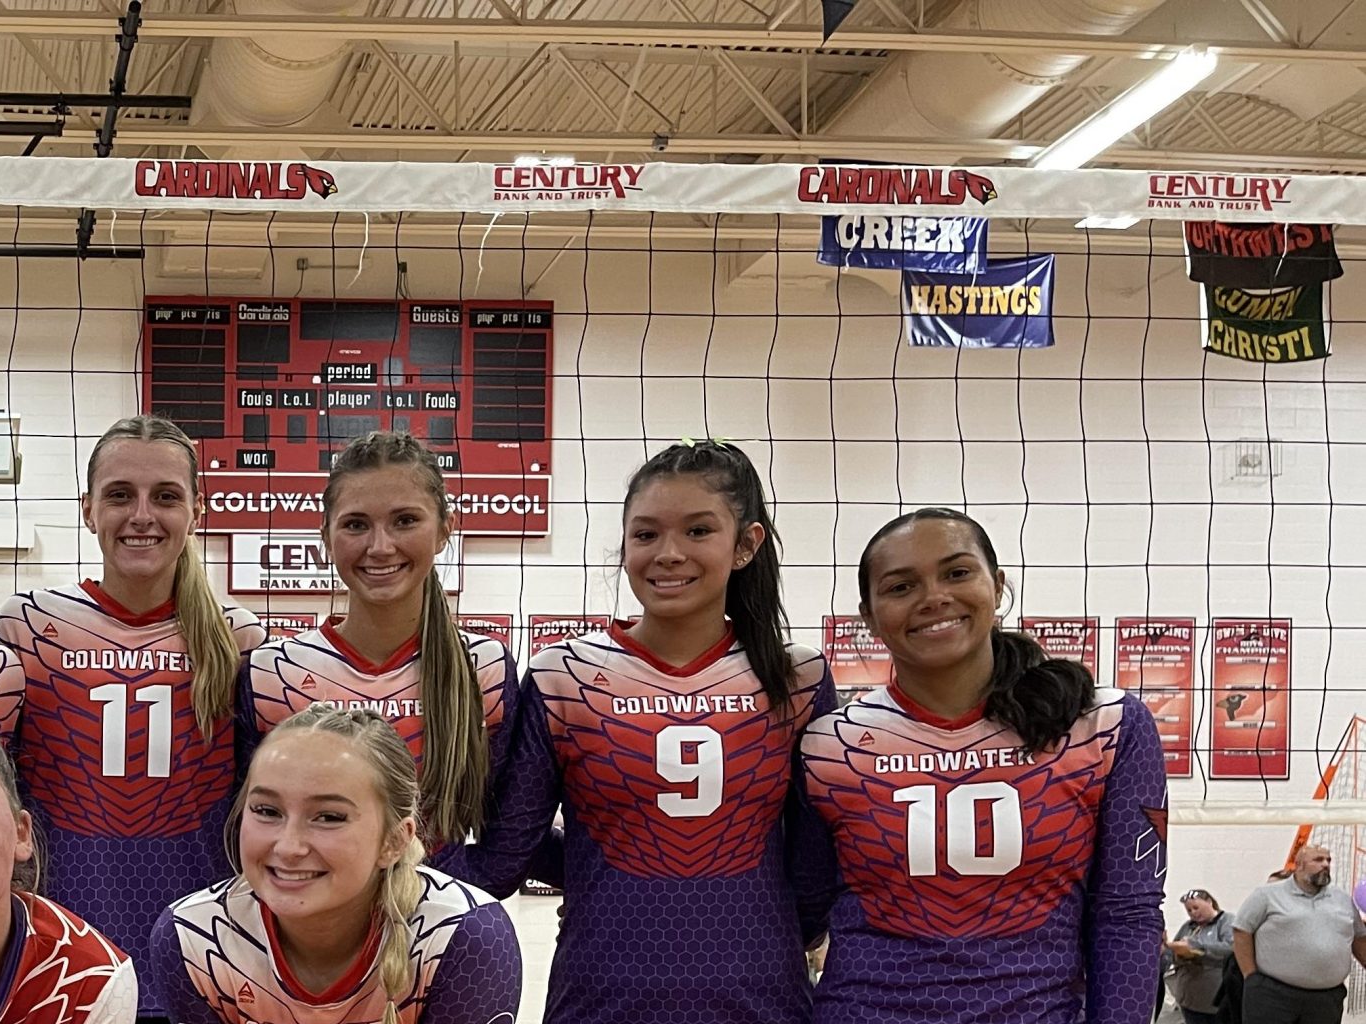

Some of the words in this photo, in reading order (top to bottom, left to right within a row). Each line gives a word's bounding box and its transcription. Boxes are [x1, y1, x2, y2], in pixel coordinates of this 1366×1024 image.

[134, 160, 306, 199] CARDINALS
[494, 165, 644, 199] CENTURY
[797, 166, 966, 205] CARDINALS
[494, 191, 530, 201] BANK
[535, 191, 564, 200] AND
[570, 190, 610, 200] TRUST
[1148, 174, 1291, 211] CENTURY
[1148, 200, 1183, 209] BANK
[1189, 201, 1217, 210] AND
[1220, 201, 1259, 211] TRUST
[836, 215, 966, 253] CREEK
[910, 285, 1042, 316] HASTINGS
[1214, 285, 1303, 320] LUMEN
[238, 303, 289, 321] Cardinals
[413, 306, 460, 323] Guests
[1210, 319, 1314, 362] CHRISTI
[327, 363, 371, 381] period
[241, 390, 273, 406] fous
[327, 390, 371, 409] player
[425, 392, 457, 408] fouls
[435, 455, 453, 467] on
[210, 492, 326, 512] COLDWAT
[445, 494, 546, 515] SCHOOL
[259, 579, 301, 589] BANK
[826, 643, 887, 651] CHAMPIO
[1118, 644, 1191, 653] CHAMPIONS
[1215, 646, 1287, 654] CHAMPIONS
[611, 694, 758, 715] COLDWATER
[89, 683, 173, 778] 11
[655, 724, 724, 818] 9
[892, 780, 1024, 877] 10
